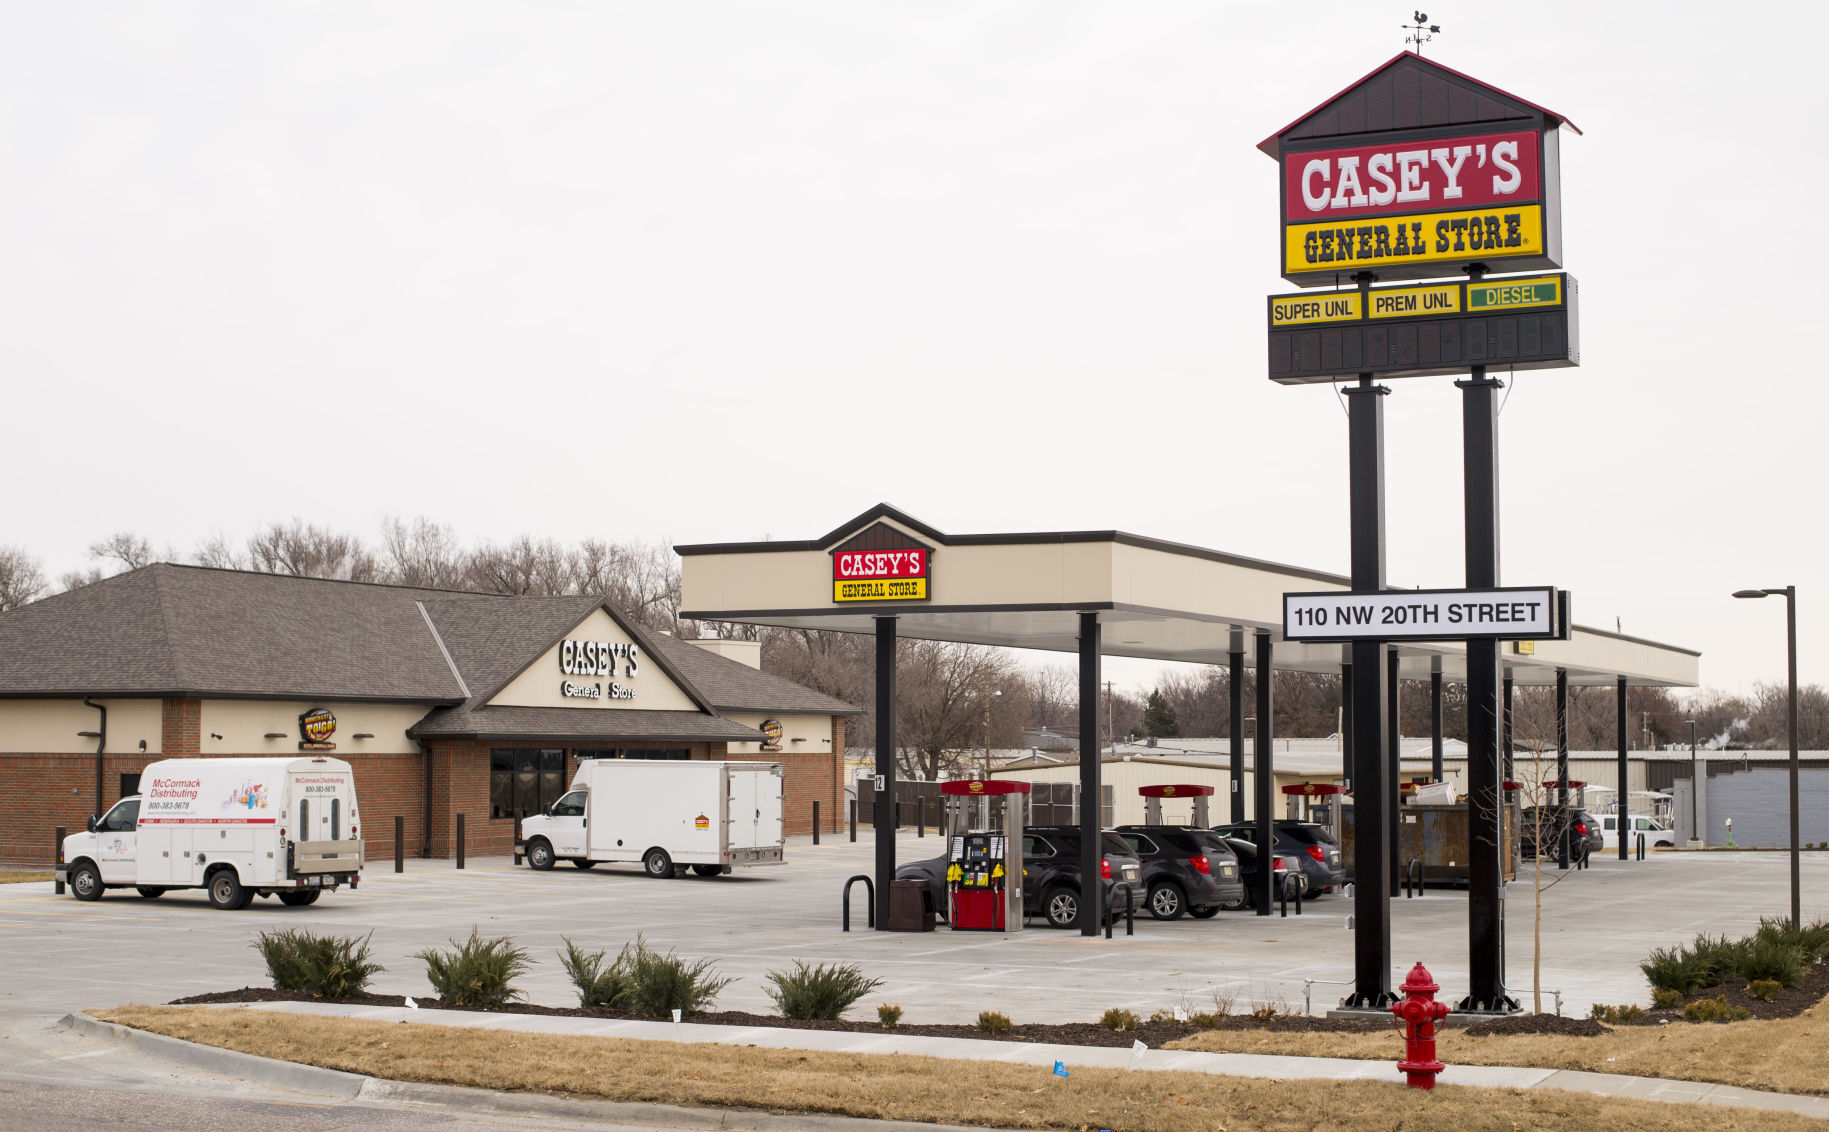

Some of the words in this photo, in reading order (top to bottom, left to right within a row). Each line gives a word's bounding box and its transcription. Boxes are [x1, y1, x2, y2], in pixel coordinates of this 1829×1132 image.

[1301, 141, 1522, 212] CASEY'S
[1304, 221, 1426, 264] GENERAL
[1376, 294, 1417, 313] PREM
[1423, 292, 1452, 310] UNL
[1486, 286, 1541, 306] DIESEL
[1274, 302, 1321, 321] SUPER
[1325, 300, 1353, 317] UNL
[840, 552, 920, 576] CASEY'S
[842, 583, 885, 598] GENERAL
[888, 581, 918, 596] STORE
[1294, 607, 1328, 626] 110
[1335, 606, 1374, 626] NW
[1381, 604, 1439, 624] 20TH
[1447, 602, 1541, 623] STREET
[560, 639, 638, 677] CASEY'S
[608, 682, 637, 699] Store
[152, 778, 201, 788] McCormack
[150, 789, 198, 800] Distributing
[148, 802, 190, 810] 800-383-5678
